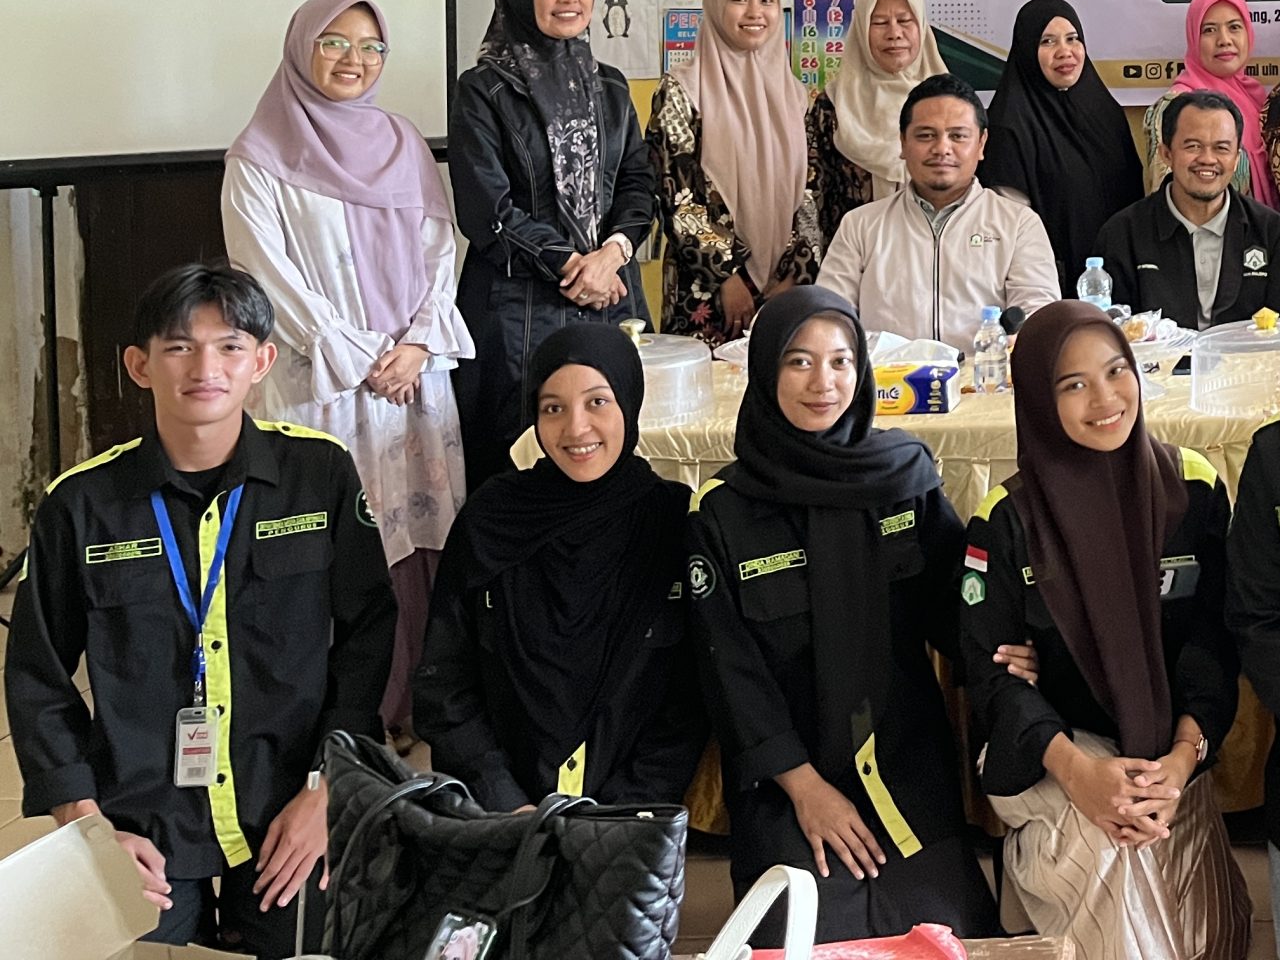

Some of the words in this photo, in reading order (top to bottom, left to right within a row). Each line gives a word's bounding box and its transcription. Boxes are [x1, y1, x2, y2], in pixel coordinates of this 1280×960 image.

[668, 12, 700, 29] PER
[828, 10, 842, 22] 12
[803, 26, 817, 37] 16
[828, 26, 843, 37] 17
[802, 42, 816, 53] 21
[825, 42, 843, 53] 22
[801, 57, 819, 68] 26
[801, 73, 817, 84] 31
